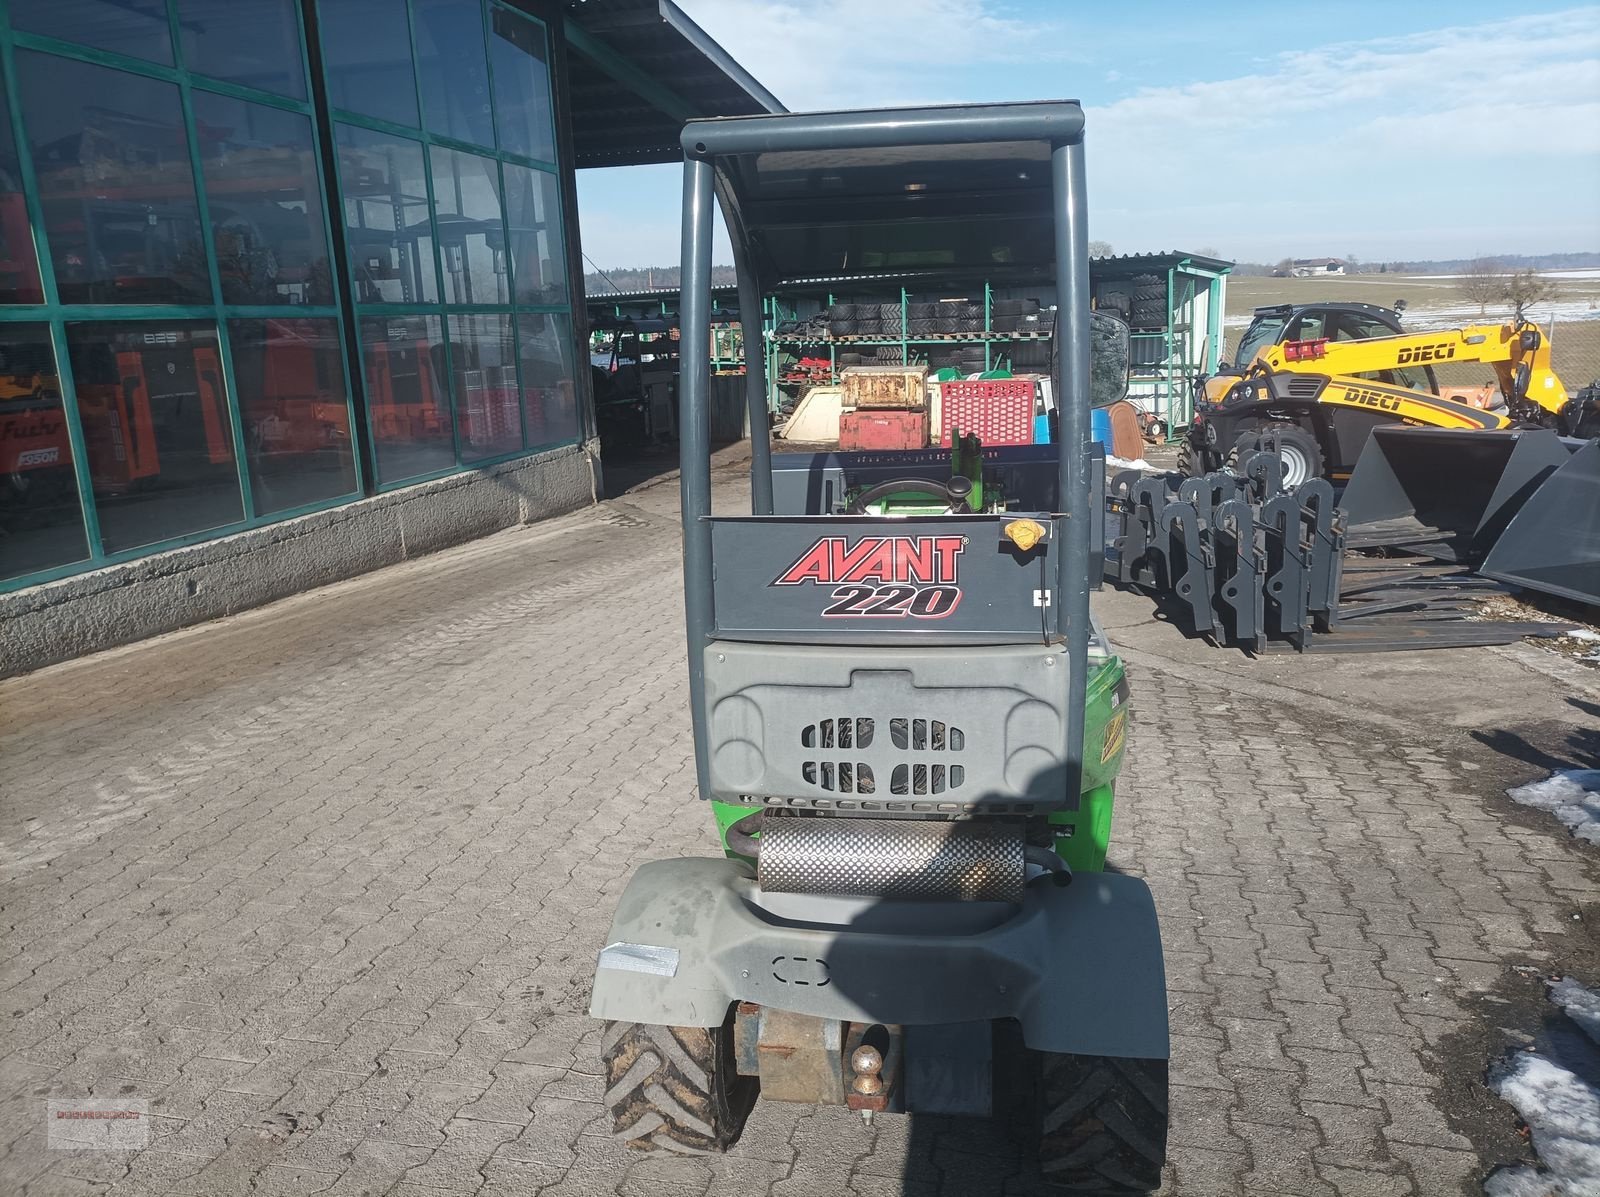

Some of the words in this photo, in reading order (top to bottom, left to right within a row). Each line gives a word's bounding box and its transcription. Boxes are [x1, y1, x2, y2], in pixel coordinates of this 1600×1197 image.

[144, 332, 177, 343] 825
[1397, 343, 1456, 364] DIECI
[1344, 388, 1402, 410] DIECI
[820, 583, 961, 618] 220
